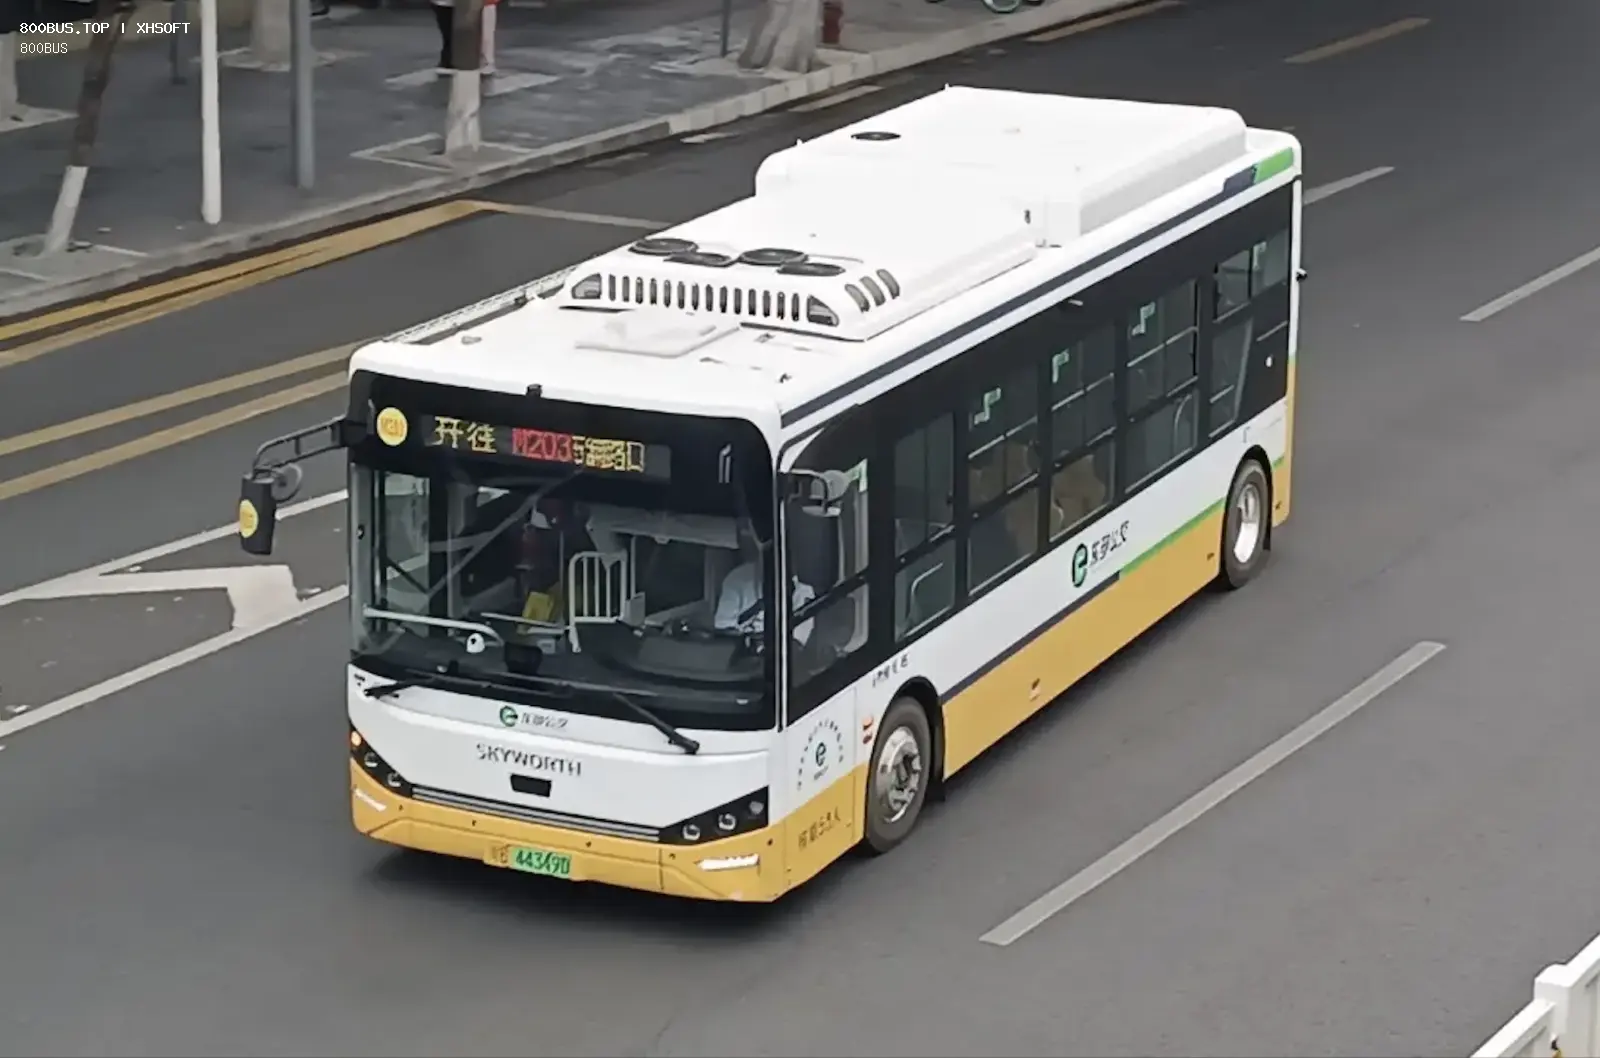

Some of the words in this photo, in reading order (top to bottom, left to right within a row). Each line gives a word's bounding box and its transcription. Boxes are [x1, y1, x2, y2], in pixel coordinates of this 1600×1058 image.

[434, 415, 498, 453] 开往
[511, 427, 574, 462] M203
[476, 742, 581, 776] SKYWORTH
